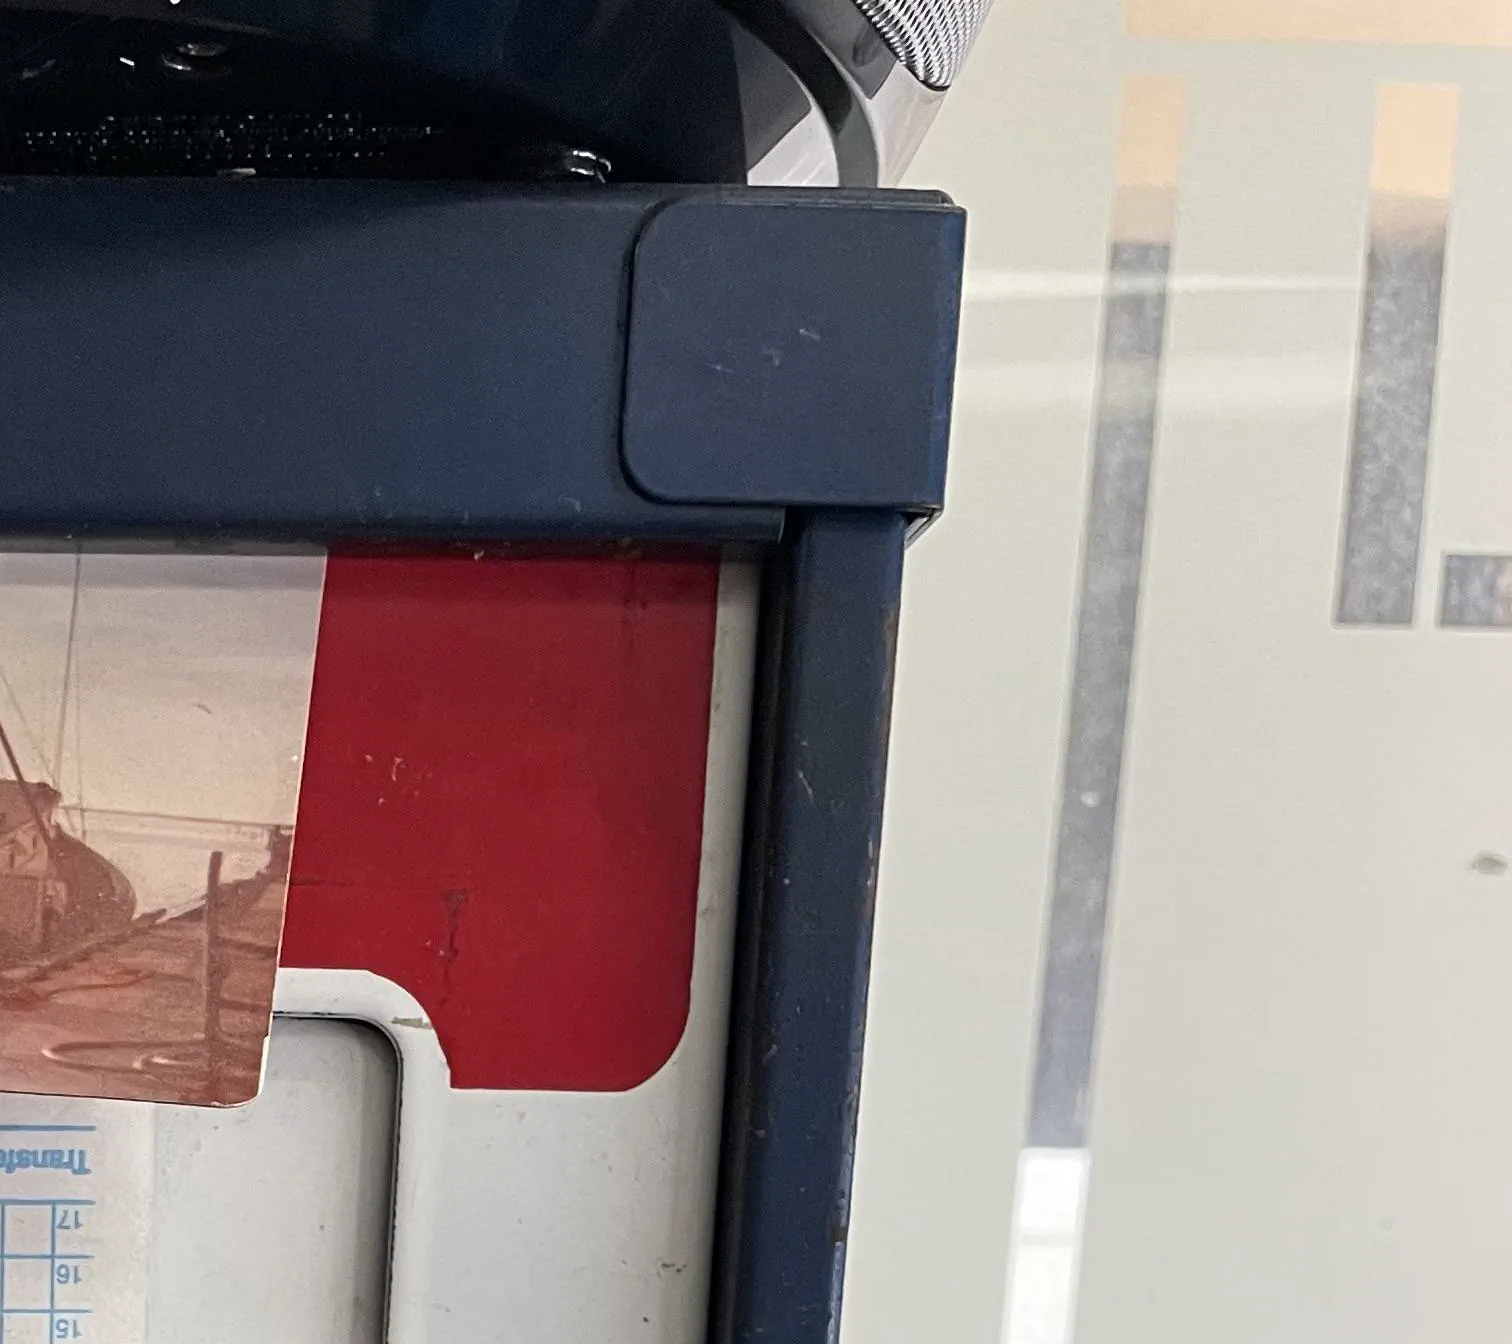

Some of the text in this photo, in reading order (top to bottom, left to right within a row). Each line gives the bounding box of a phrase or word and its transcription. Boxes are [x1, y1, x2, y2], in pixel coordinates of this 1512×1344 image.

[57, 1208, 83, 1230] 17
[56, 1264, 83, 1284] 16
[56, 1318, 82, 1339] 15
